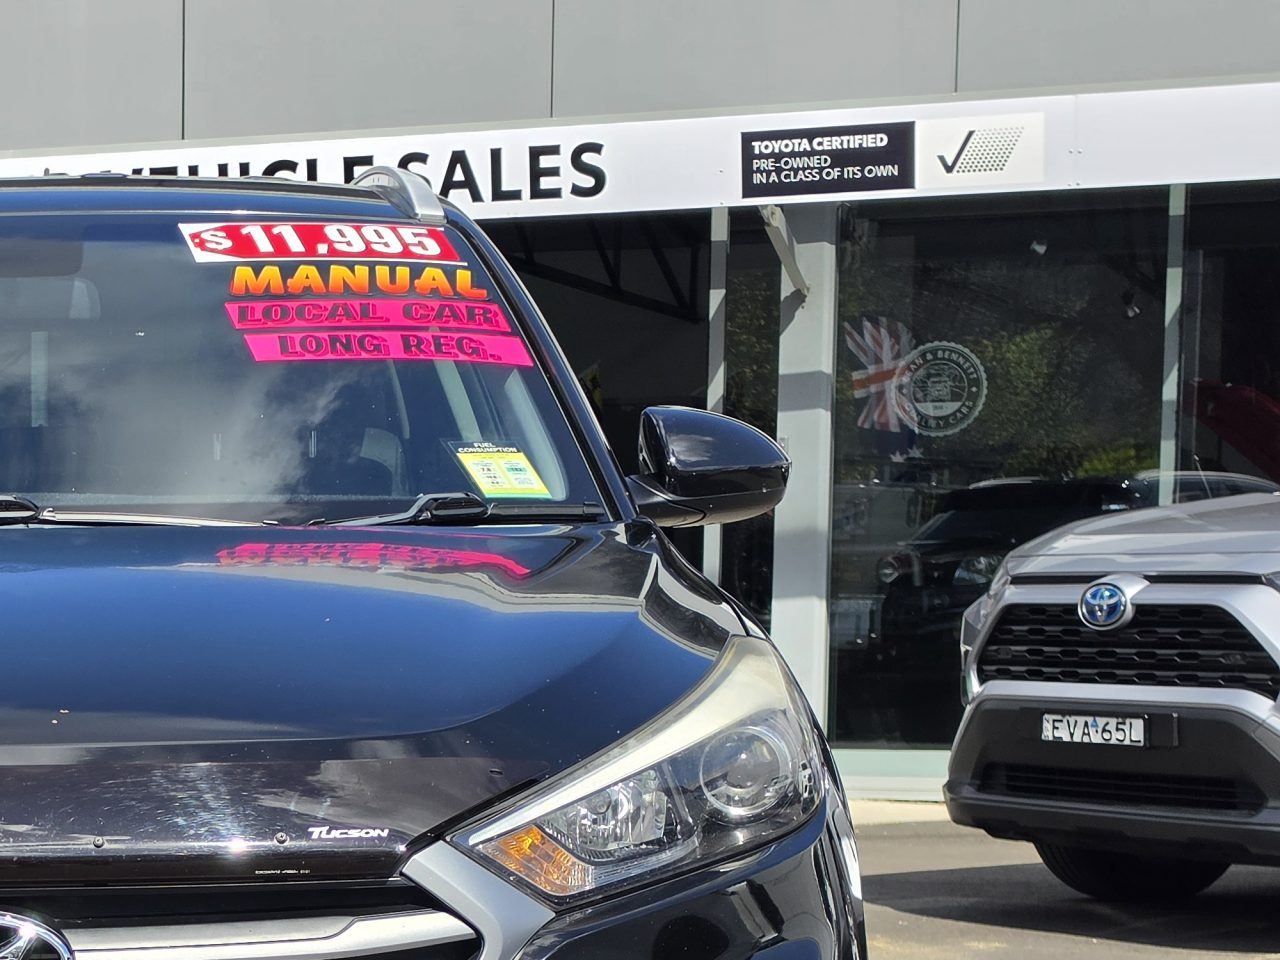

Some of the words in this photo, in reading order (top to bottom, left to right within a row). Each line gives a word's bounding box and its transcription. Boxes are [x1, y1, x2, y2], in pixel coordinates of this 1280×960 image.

[751, 139, 811, 154] TOYOTA
[812, 133, 888, 151] CERTIFIED
[752, 155, 831, 171] PRE-OWNED
[752, 172, 767, 184] IN
[768, 171, 779, 183] A
[780, 169, 820, 182] CLASS
[822, 167, 842, 180] OF
[843, 166, 862, 179] ITS
[864, 164, 899, 178] OWN
[230, 265, 488, 298] MANUAL
[237, 302, 390, 325] LOCAL
[401, 303, 501, 328] CAR
[277, 333, 391, 358] LONG
[937, 350, 977, 379] BENNETT
